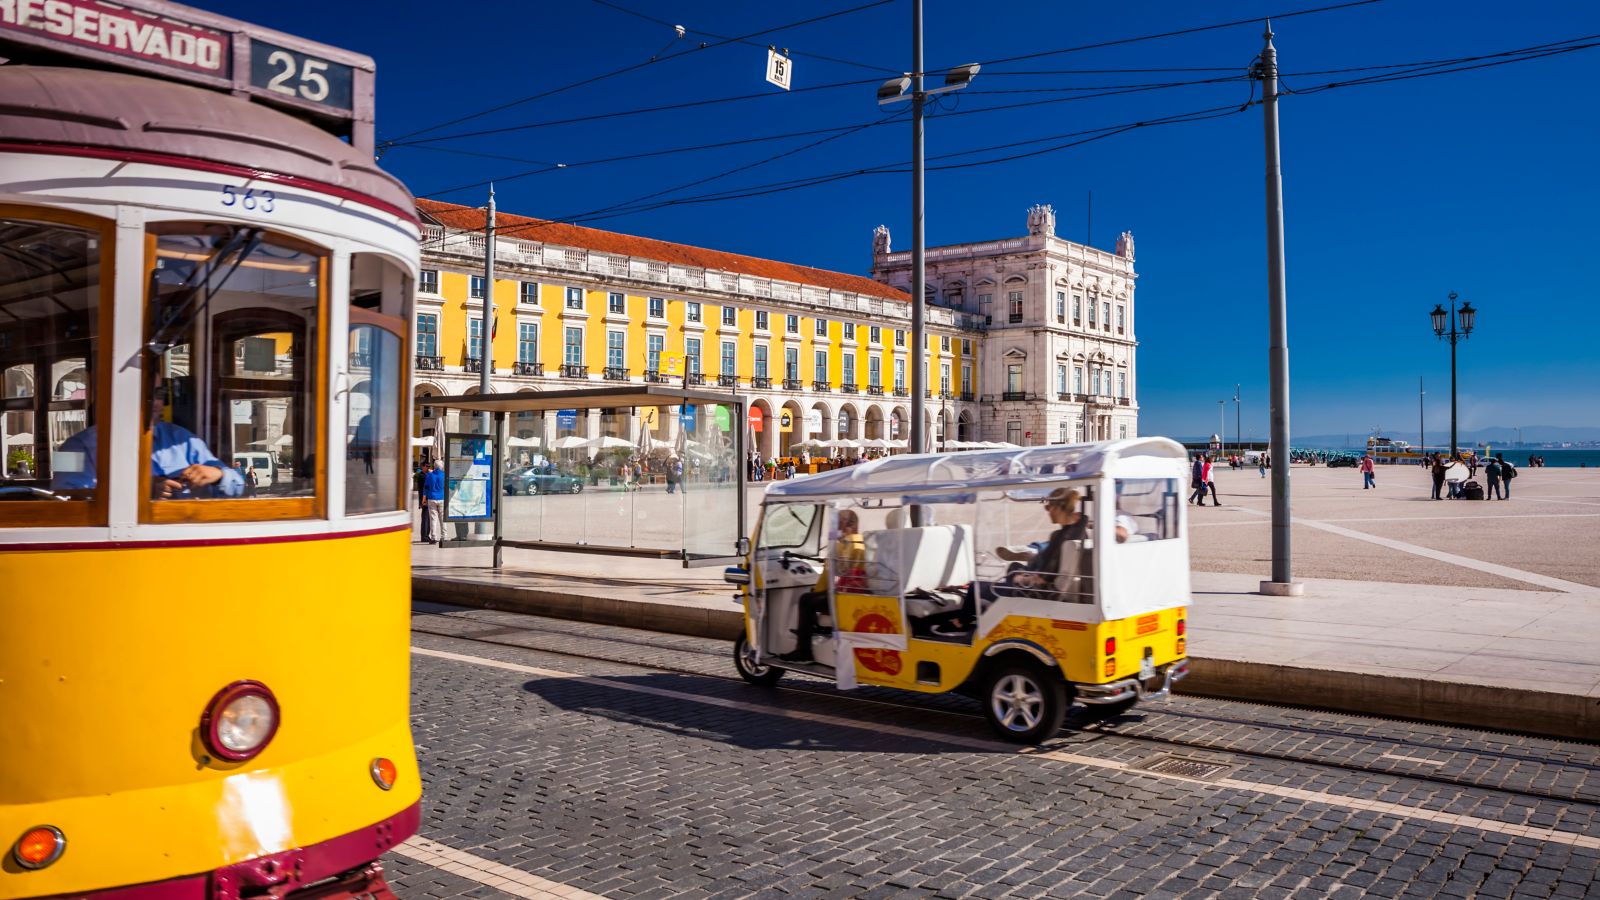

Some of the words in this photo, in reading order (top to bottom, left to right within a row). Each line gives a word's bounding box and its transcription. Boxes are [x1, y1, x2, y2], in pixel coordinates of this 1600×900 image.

[267, 51, 329, 102] 25
[775, 60, 785, 76] 15
[221, 184, 275, 213] 563
